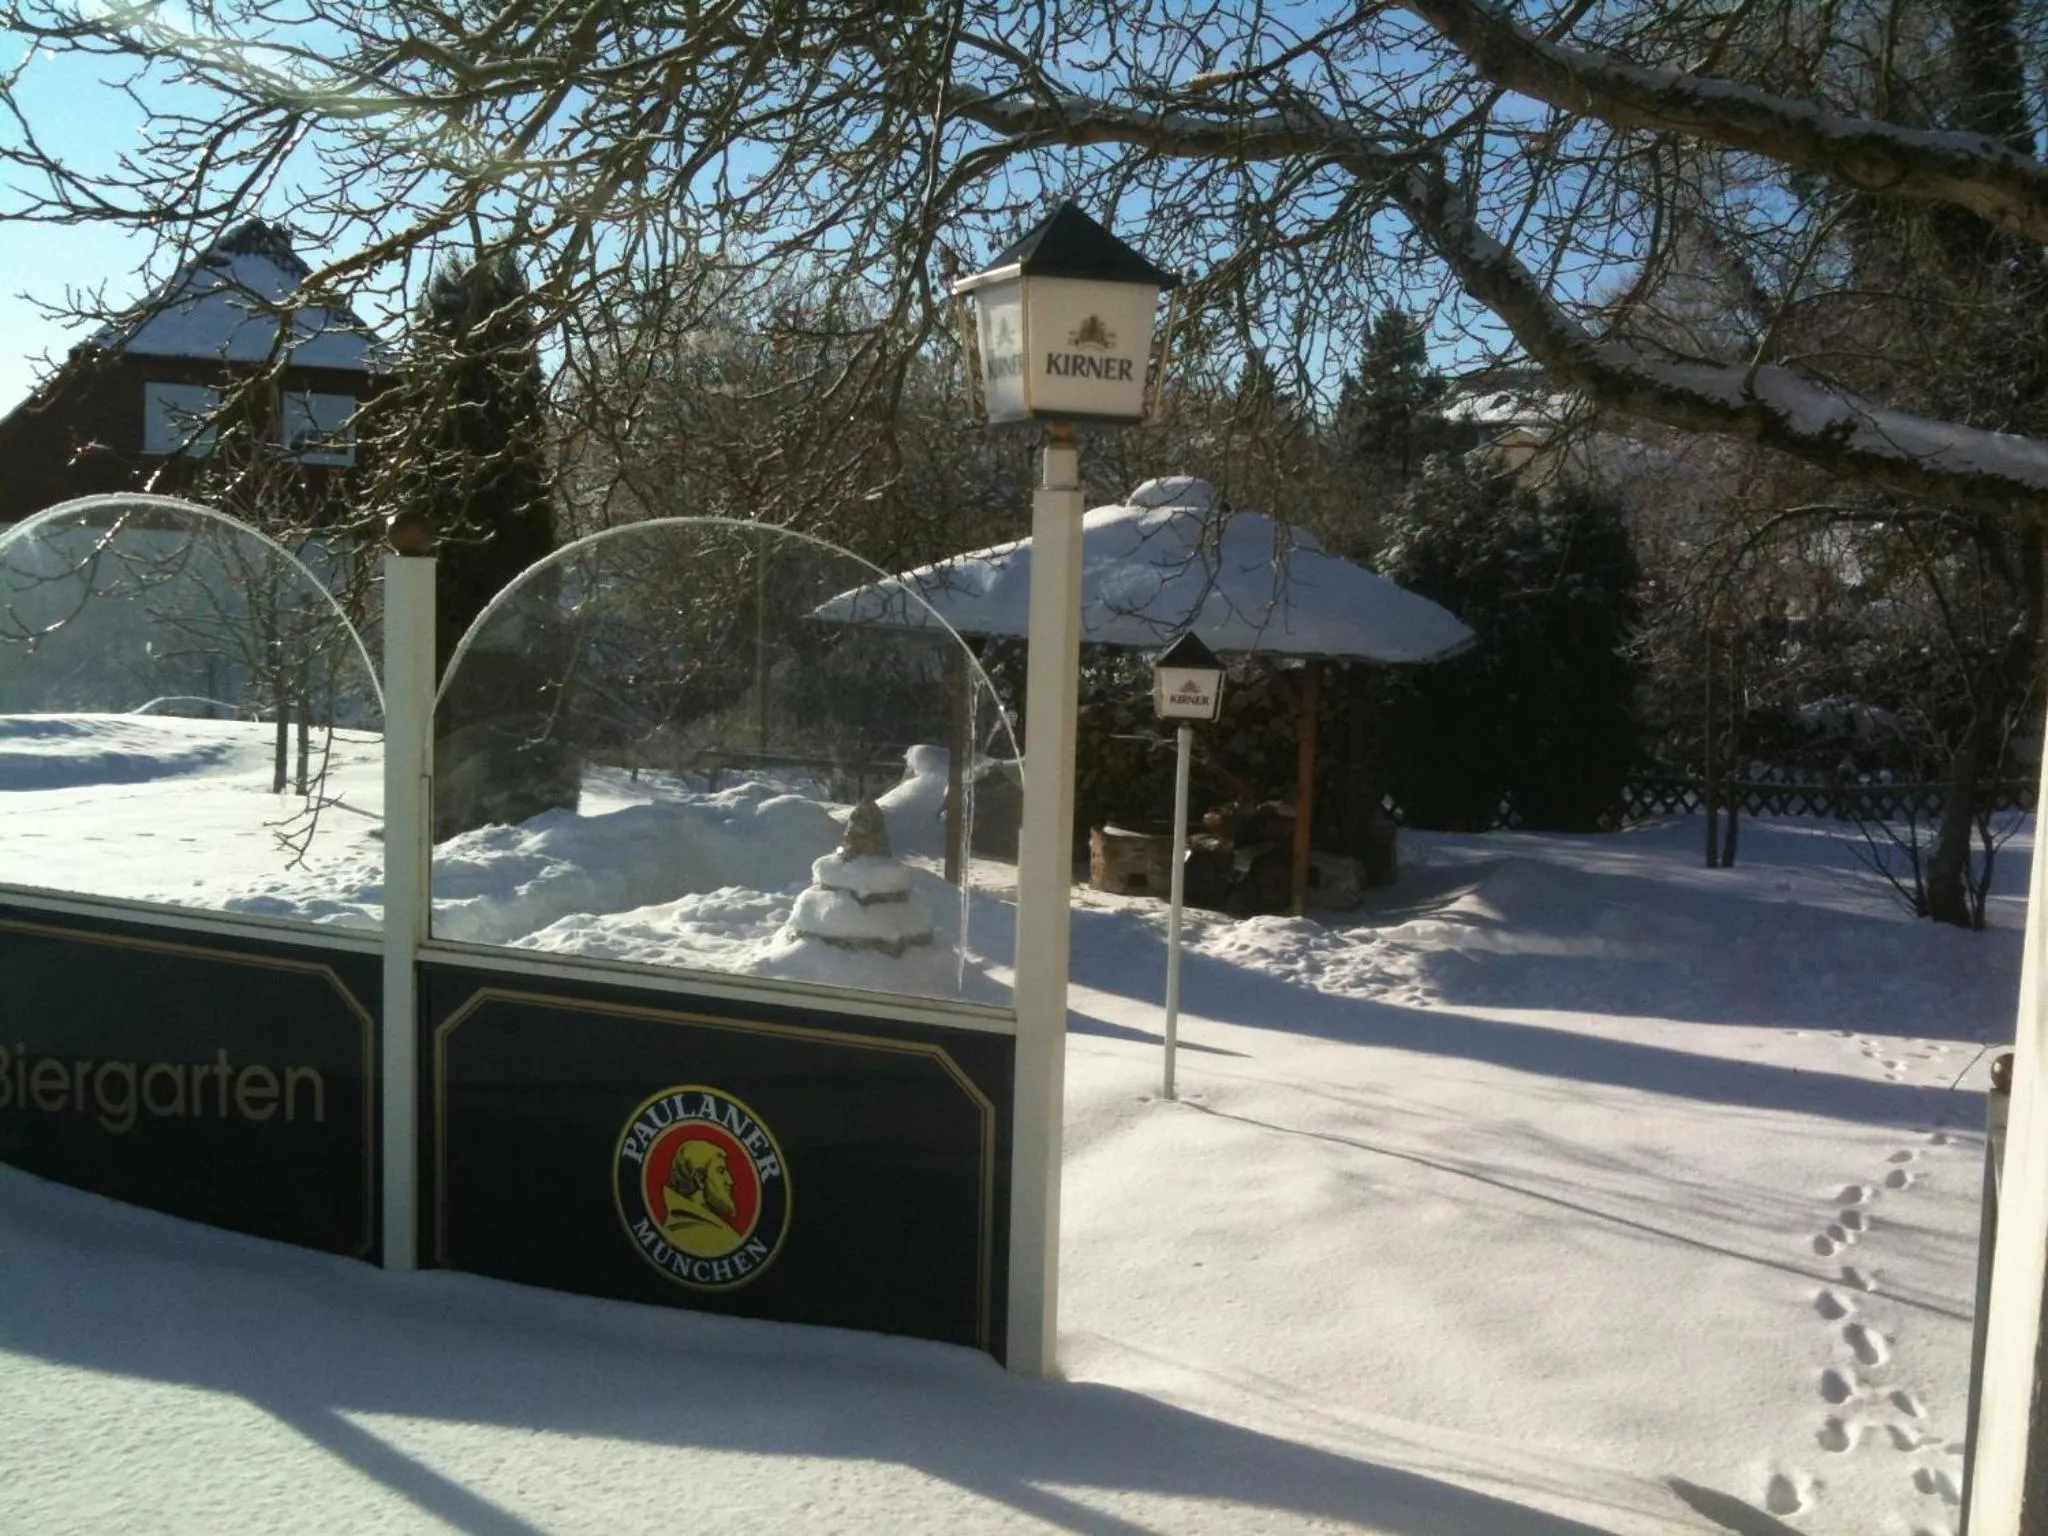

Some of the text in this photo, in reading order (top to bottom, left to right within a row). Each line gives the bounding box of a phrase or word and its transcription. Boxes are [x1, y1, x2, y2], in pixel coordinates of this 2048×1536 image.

[1046, 352, 1134, 382] KIRNER
[1169, 694, 1210, 706] KIRNER
[622, 1093, 780, 1184] PAULANER
